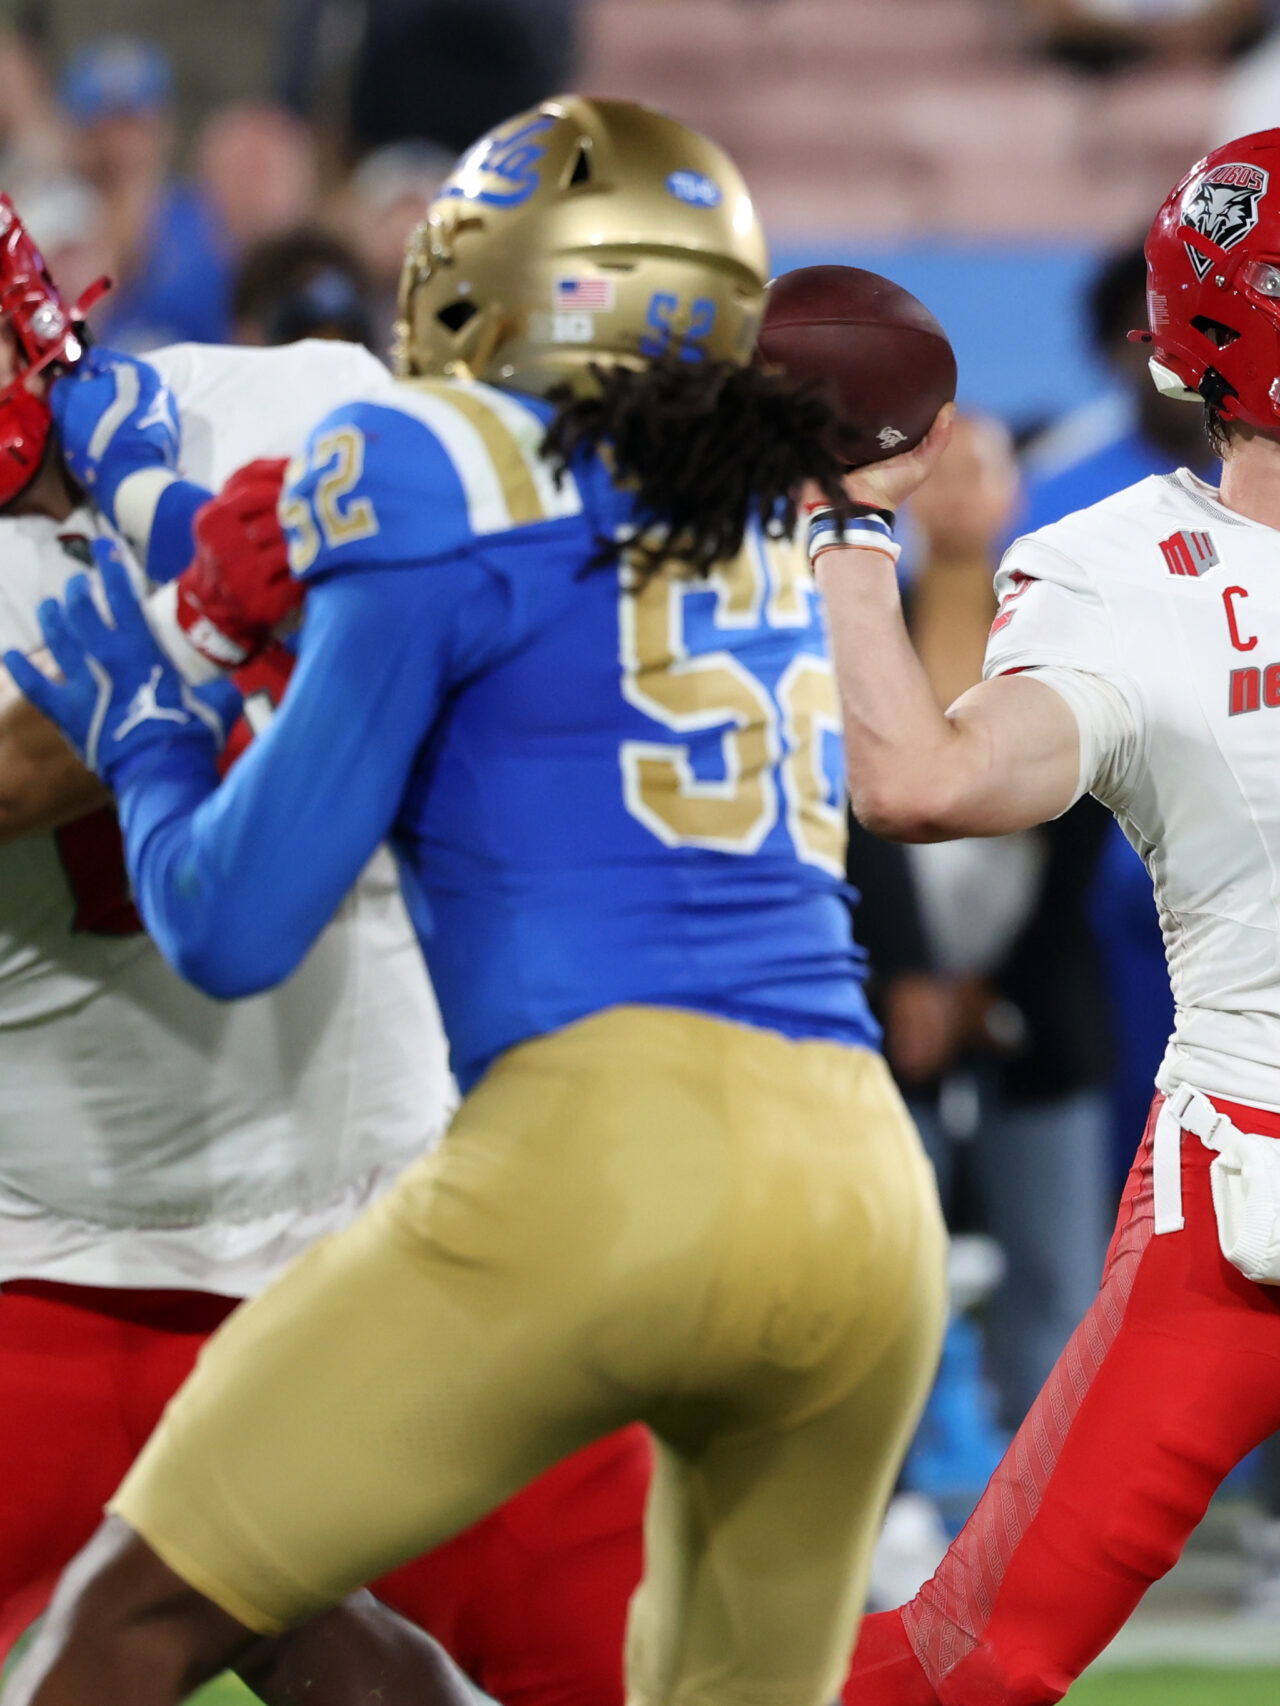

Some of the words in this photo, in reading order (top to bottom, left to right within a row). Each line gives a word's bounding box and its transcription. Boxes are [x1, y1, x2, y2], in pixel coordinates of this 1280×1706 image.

[1203, 166, 1263, 191] LOBOS
[641, 292, 717, 363] 52
[1222, 585, 1258, 652] C
